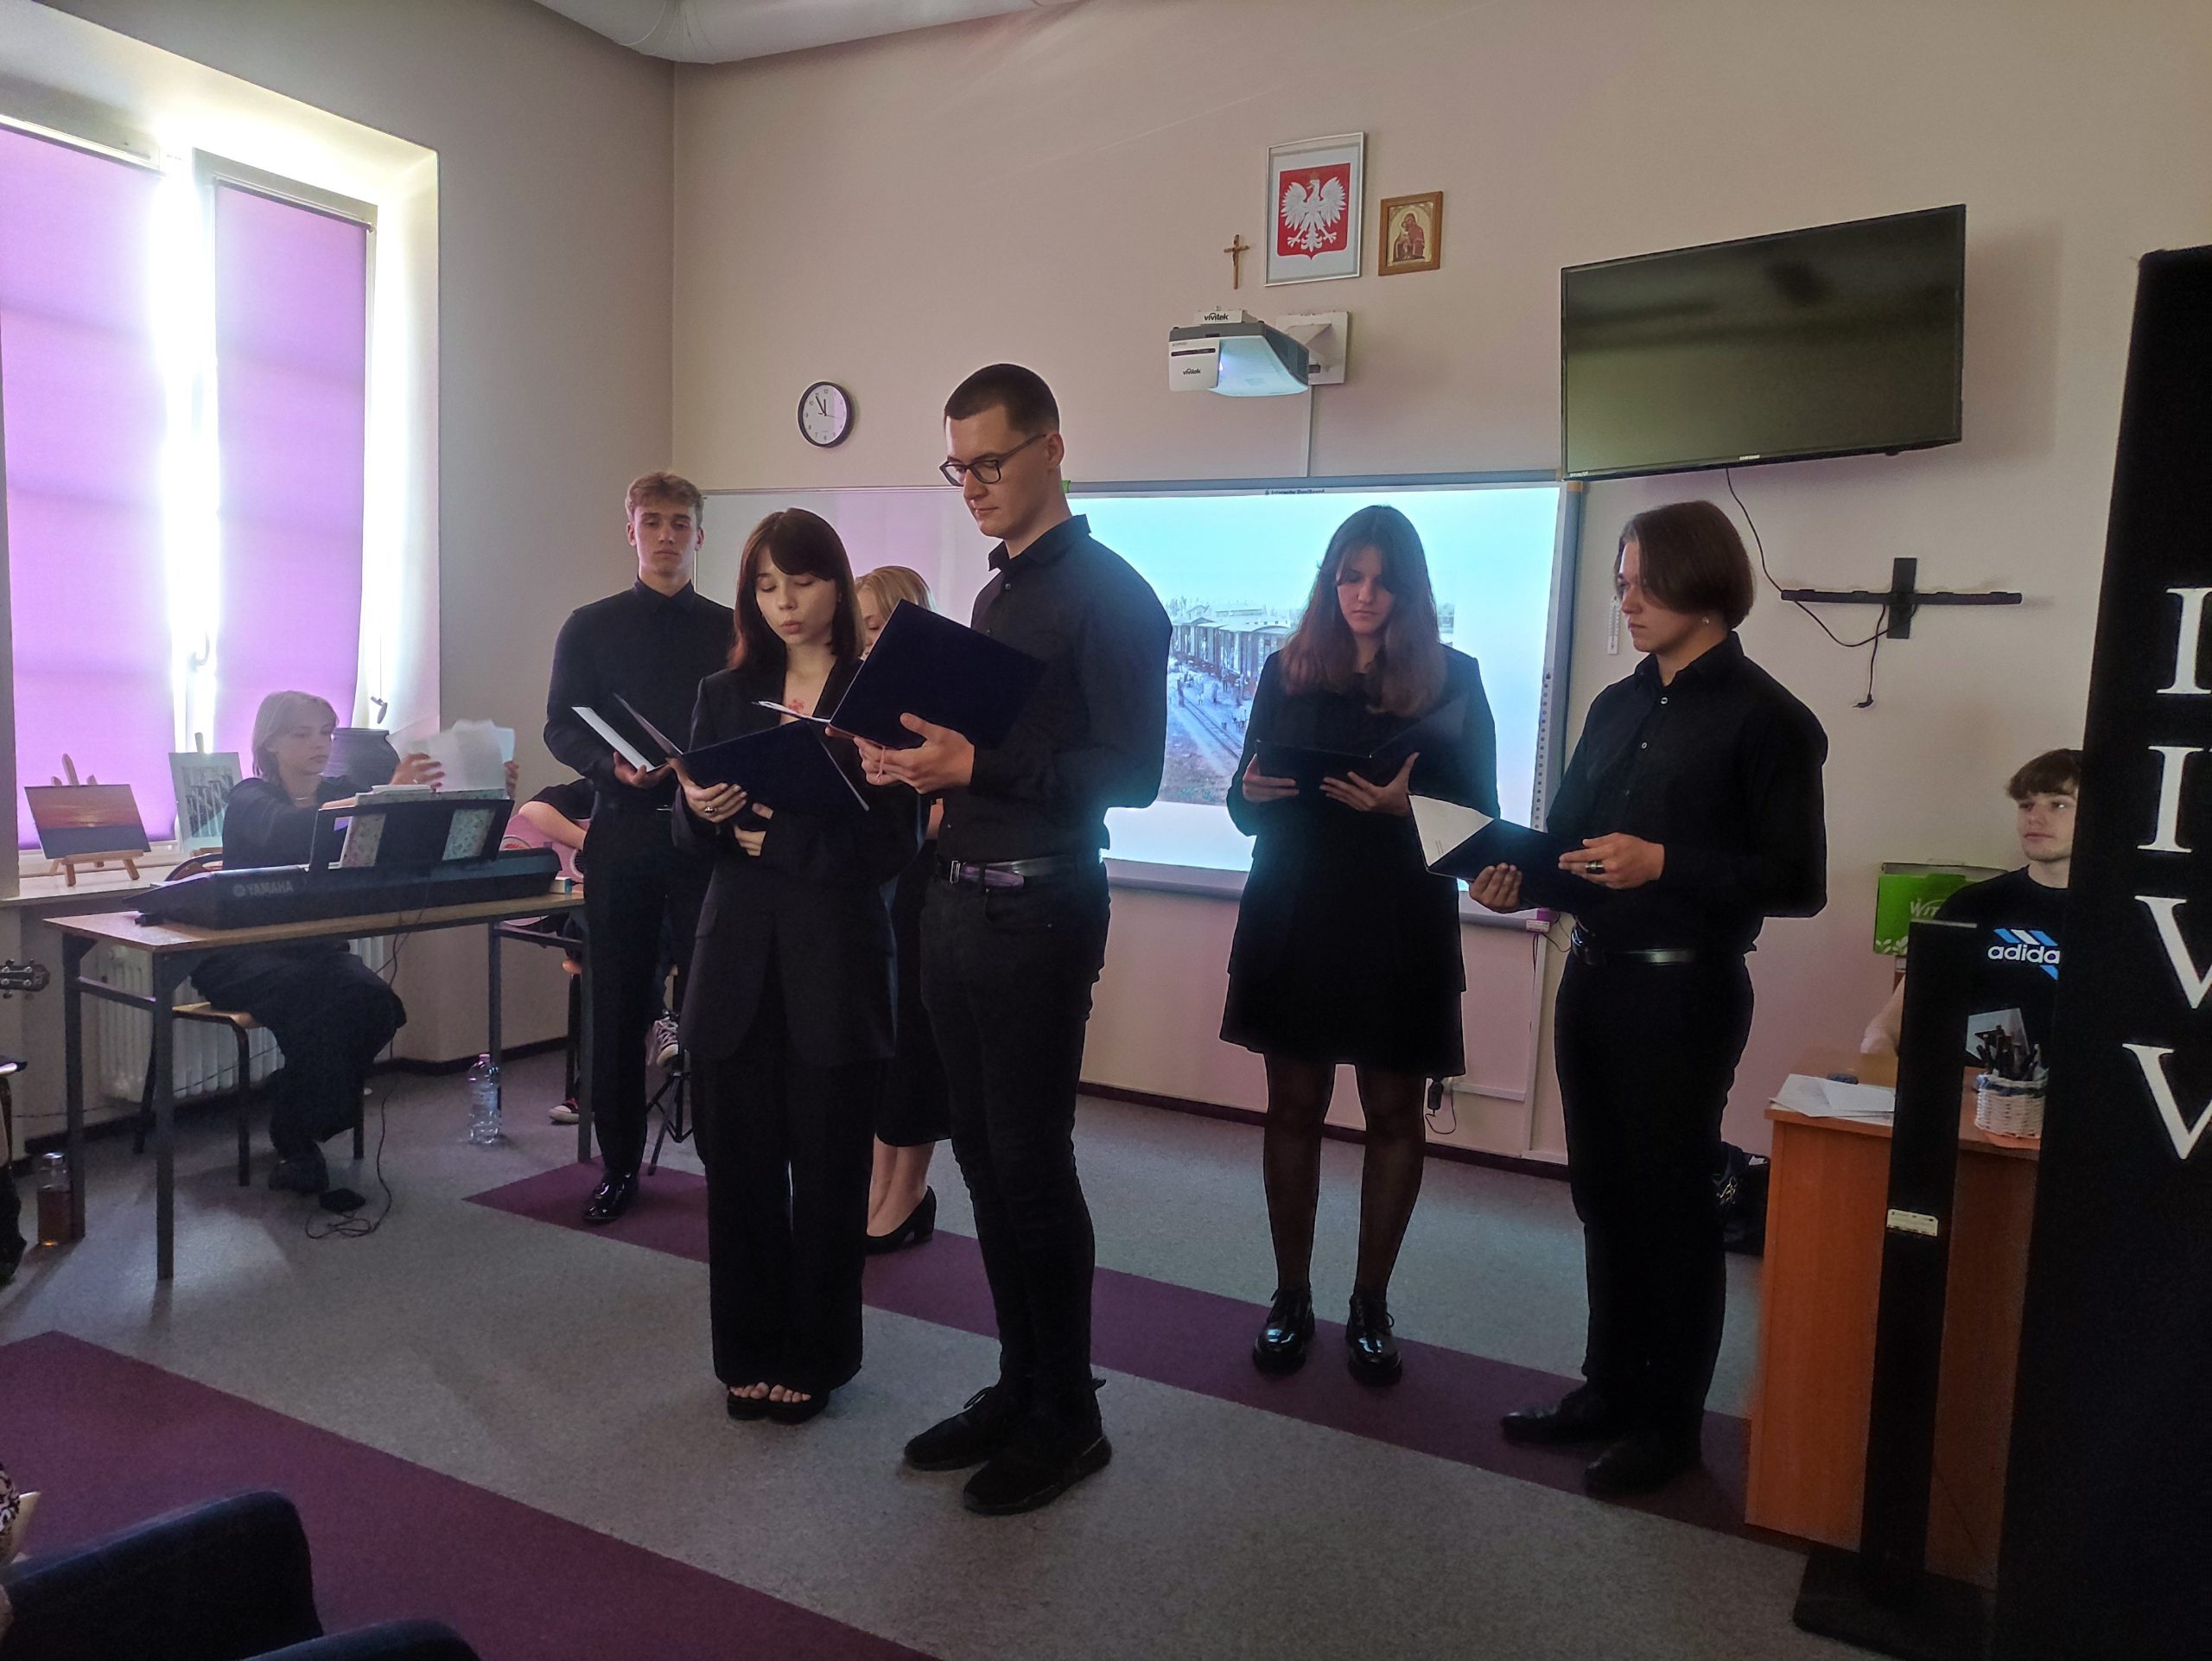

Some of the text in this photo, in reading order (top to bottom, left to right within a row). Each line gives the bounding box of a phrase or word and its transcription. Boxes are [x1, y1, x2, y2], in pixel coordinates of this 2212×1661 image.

[1204, 313, 1229, 321] vivitek
[246, 881, 295, 896] YAMAHA
[1987, 944, 2060, 964] adida
